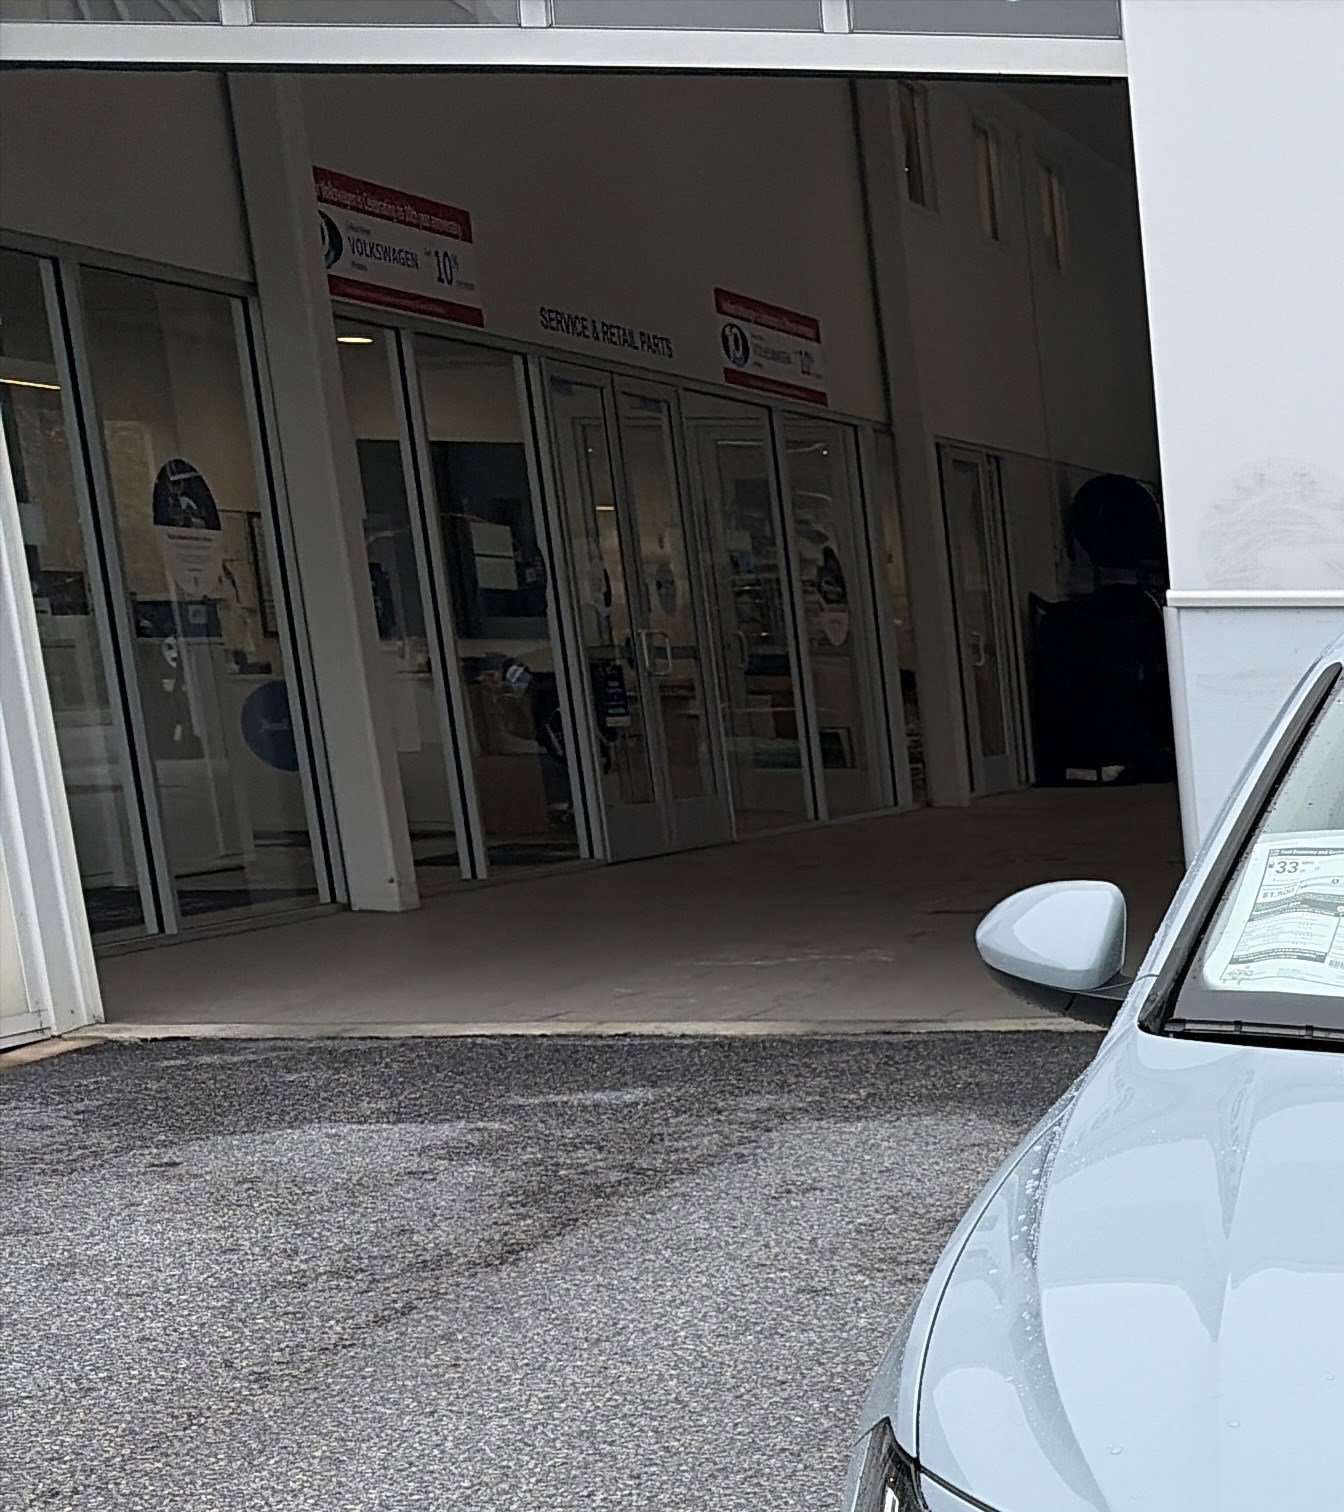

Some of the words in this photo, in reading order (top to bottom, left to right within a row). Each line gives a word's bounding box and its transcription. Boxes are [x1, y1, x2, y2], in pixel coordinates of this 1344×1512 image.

[347, 236, 420, 269] VOLKSWAGEN
[539, 306, 590, 339] SERVICE
[591, 319, 600, 342] &
[602, 321, 639, 351] RETAIL
[640, 331, 674, 358] PARTS
[1275, 860, 1299, 874] 33
